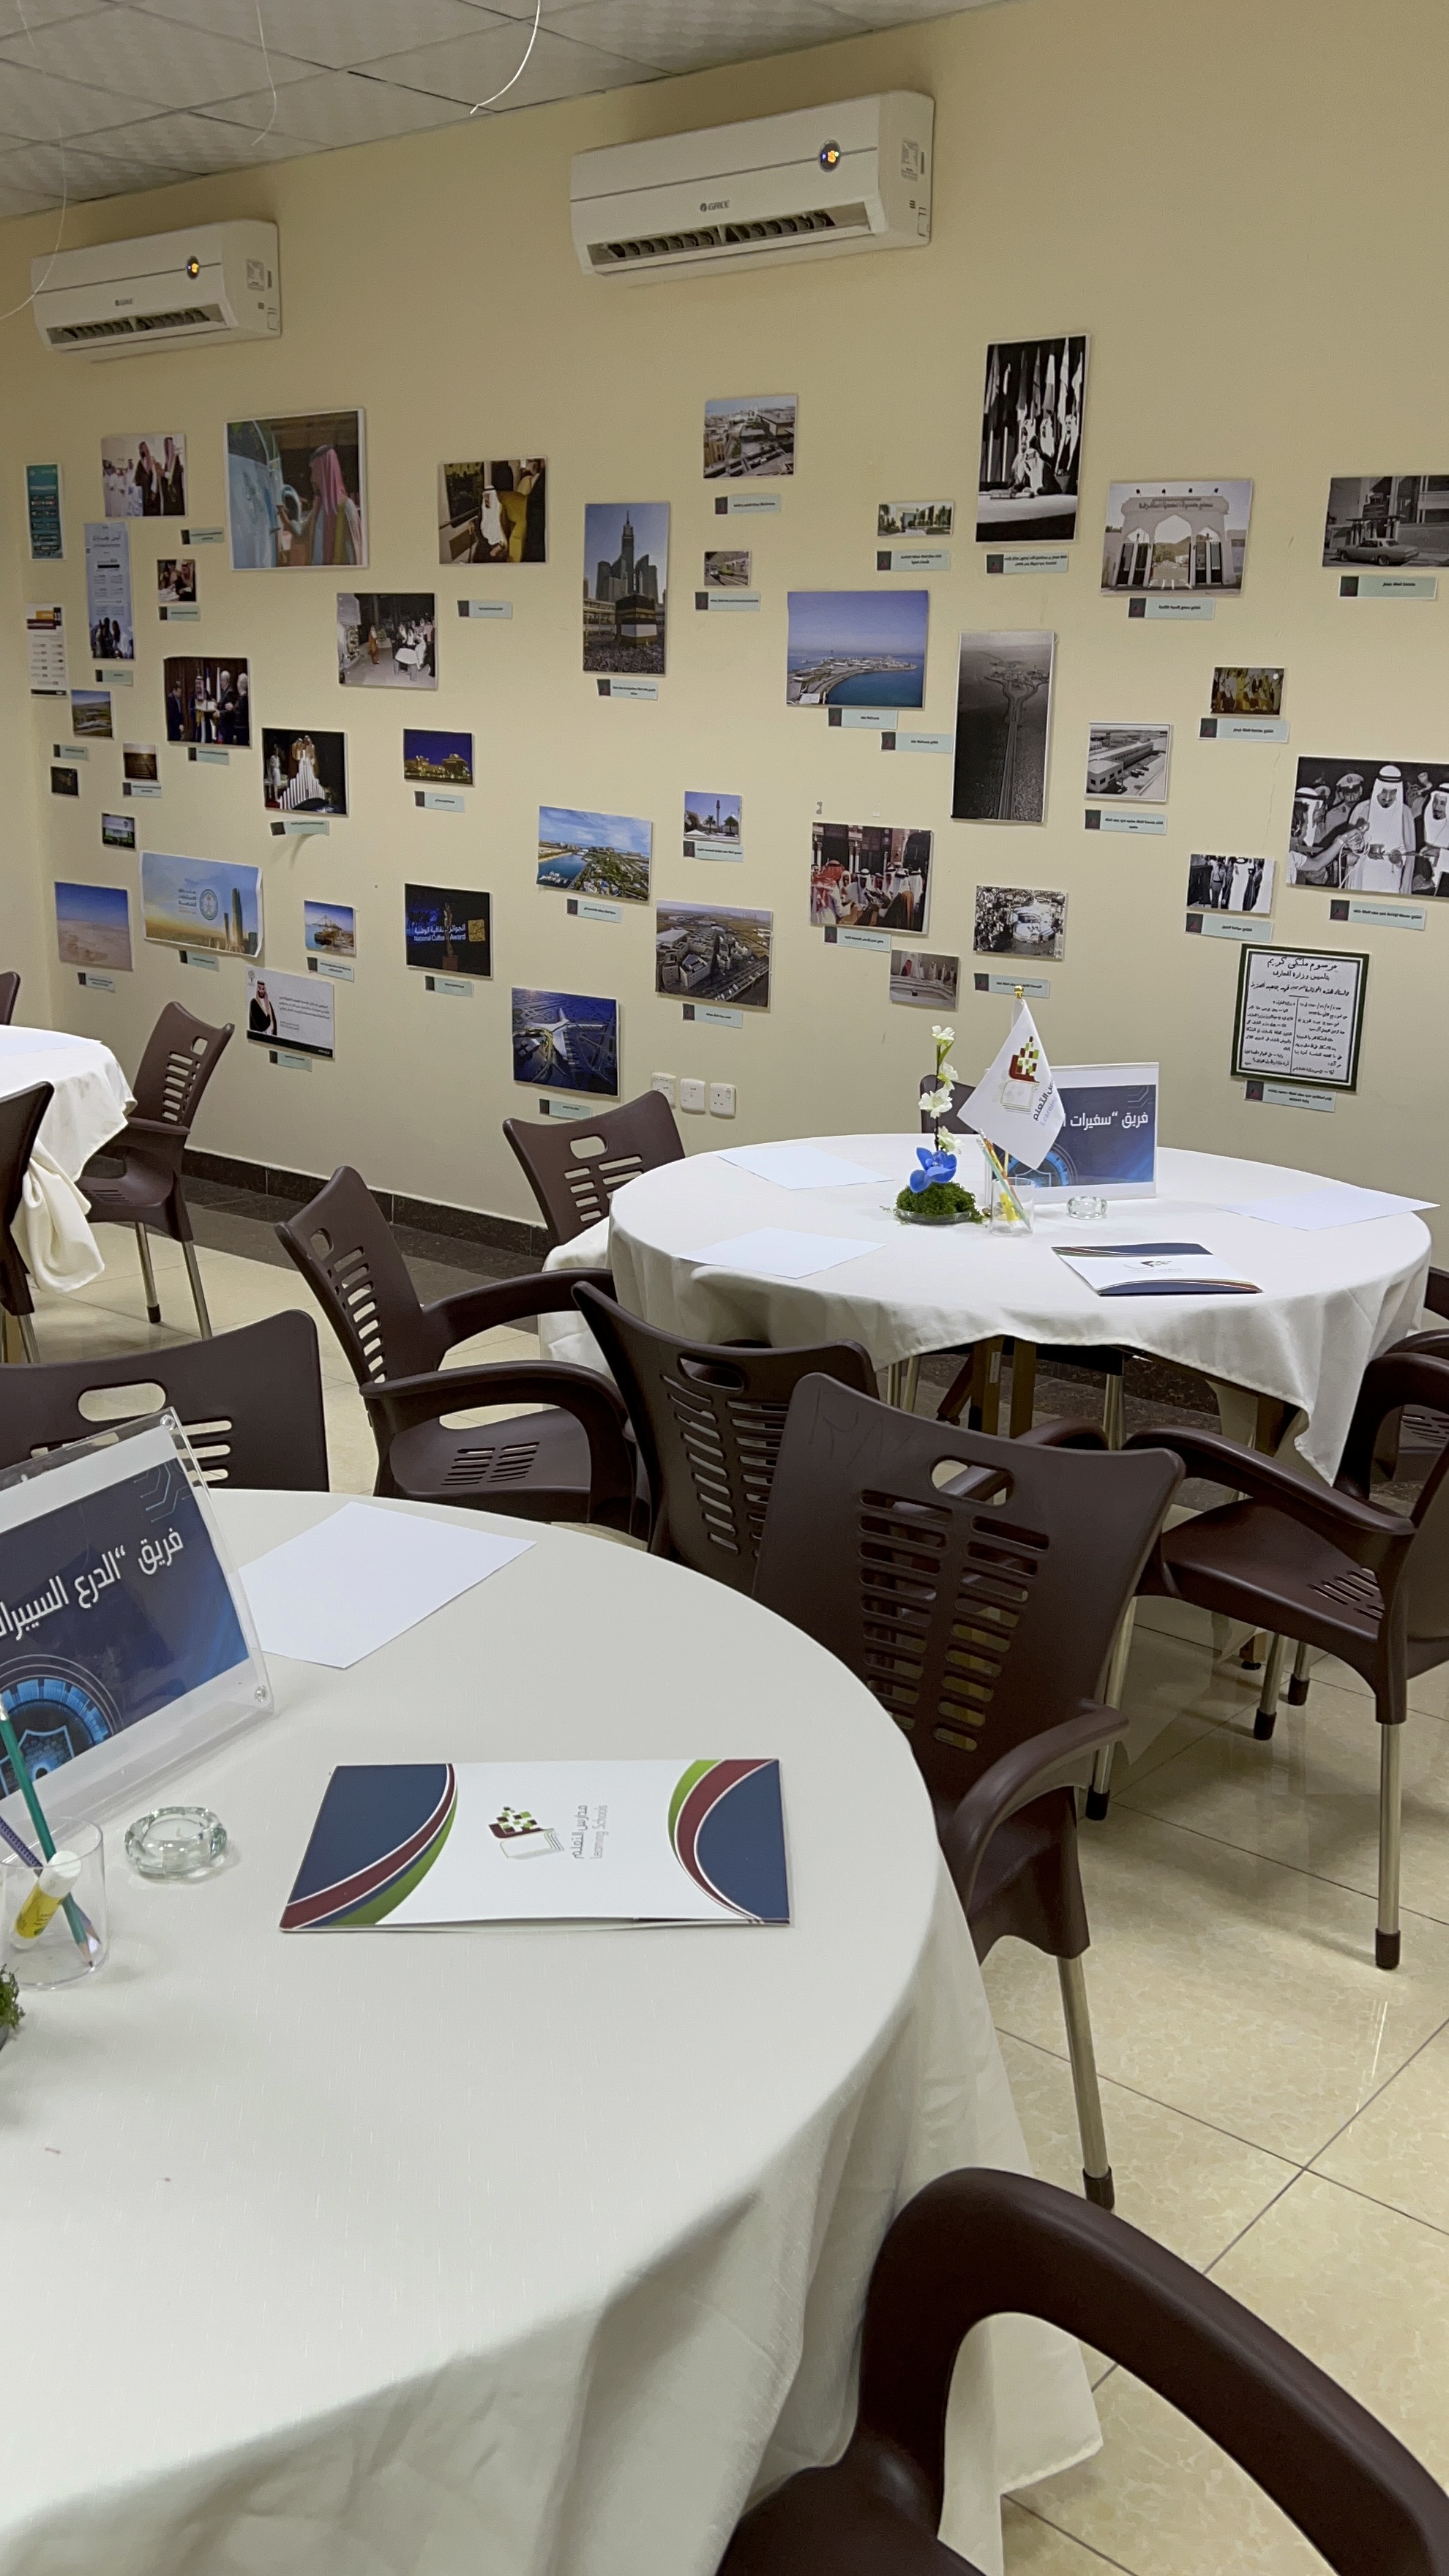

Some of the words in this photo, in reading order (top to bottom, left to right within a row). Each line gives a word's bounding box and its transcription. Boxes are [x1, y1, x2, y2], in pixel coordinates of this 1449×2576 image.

[1267, 956, 1287, 967] كريم
[1309, 962, 1338, 972] مرسوم
[1121, 1112, 1149, 1128] فريق
[138, 1527, 184, 1576] فريق
[574, 1804, 590, 1831] مدارس
[591, 1804, 608, 1830] Schools
[569, 1831, 585, 1860] التعلم
[589, 1830, 610, 1860] Learning
